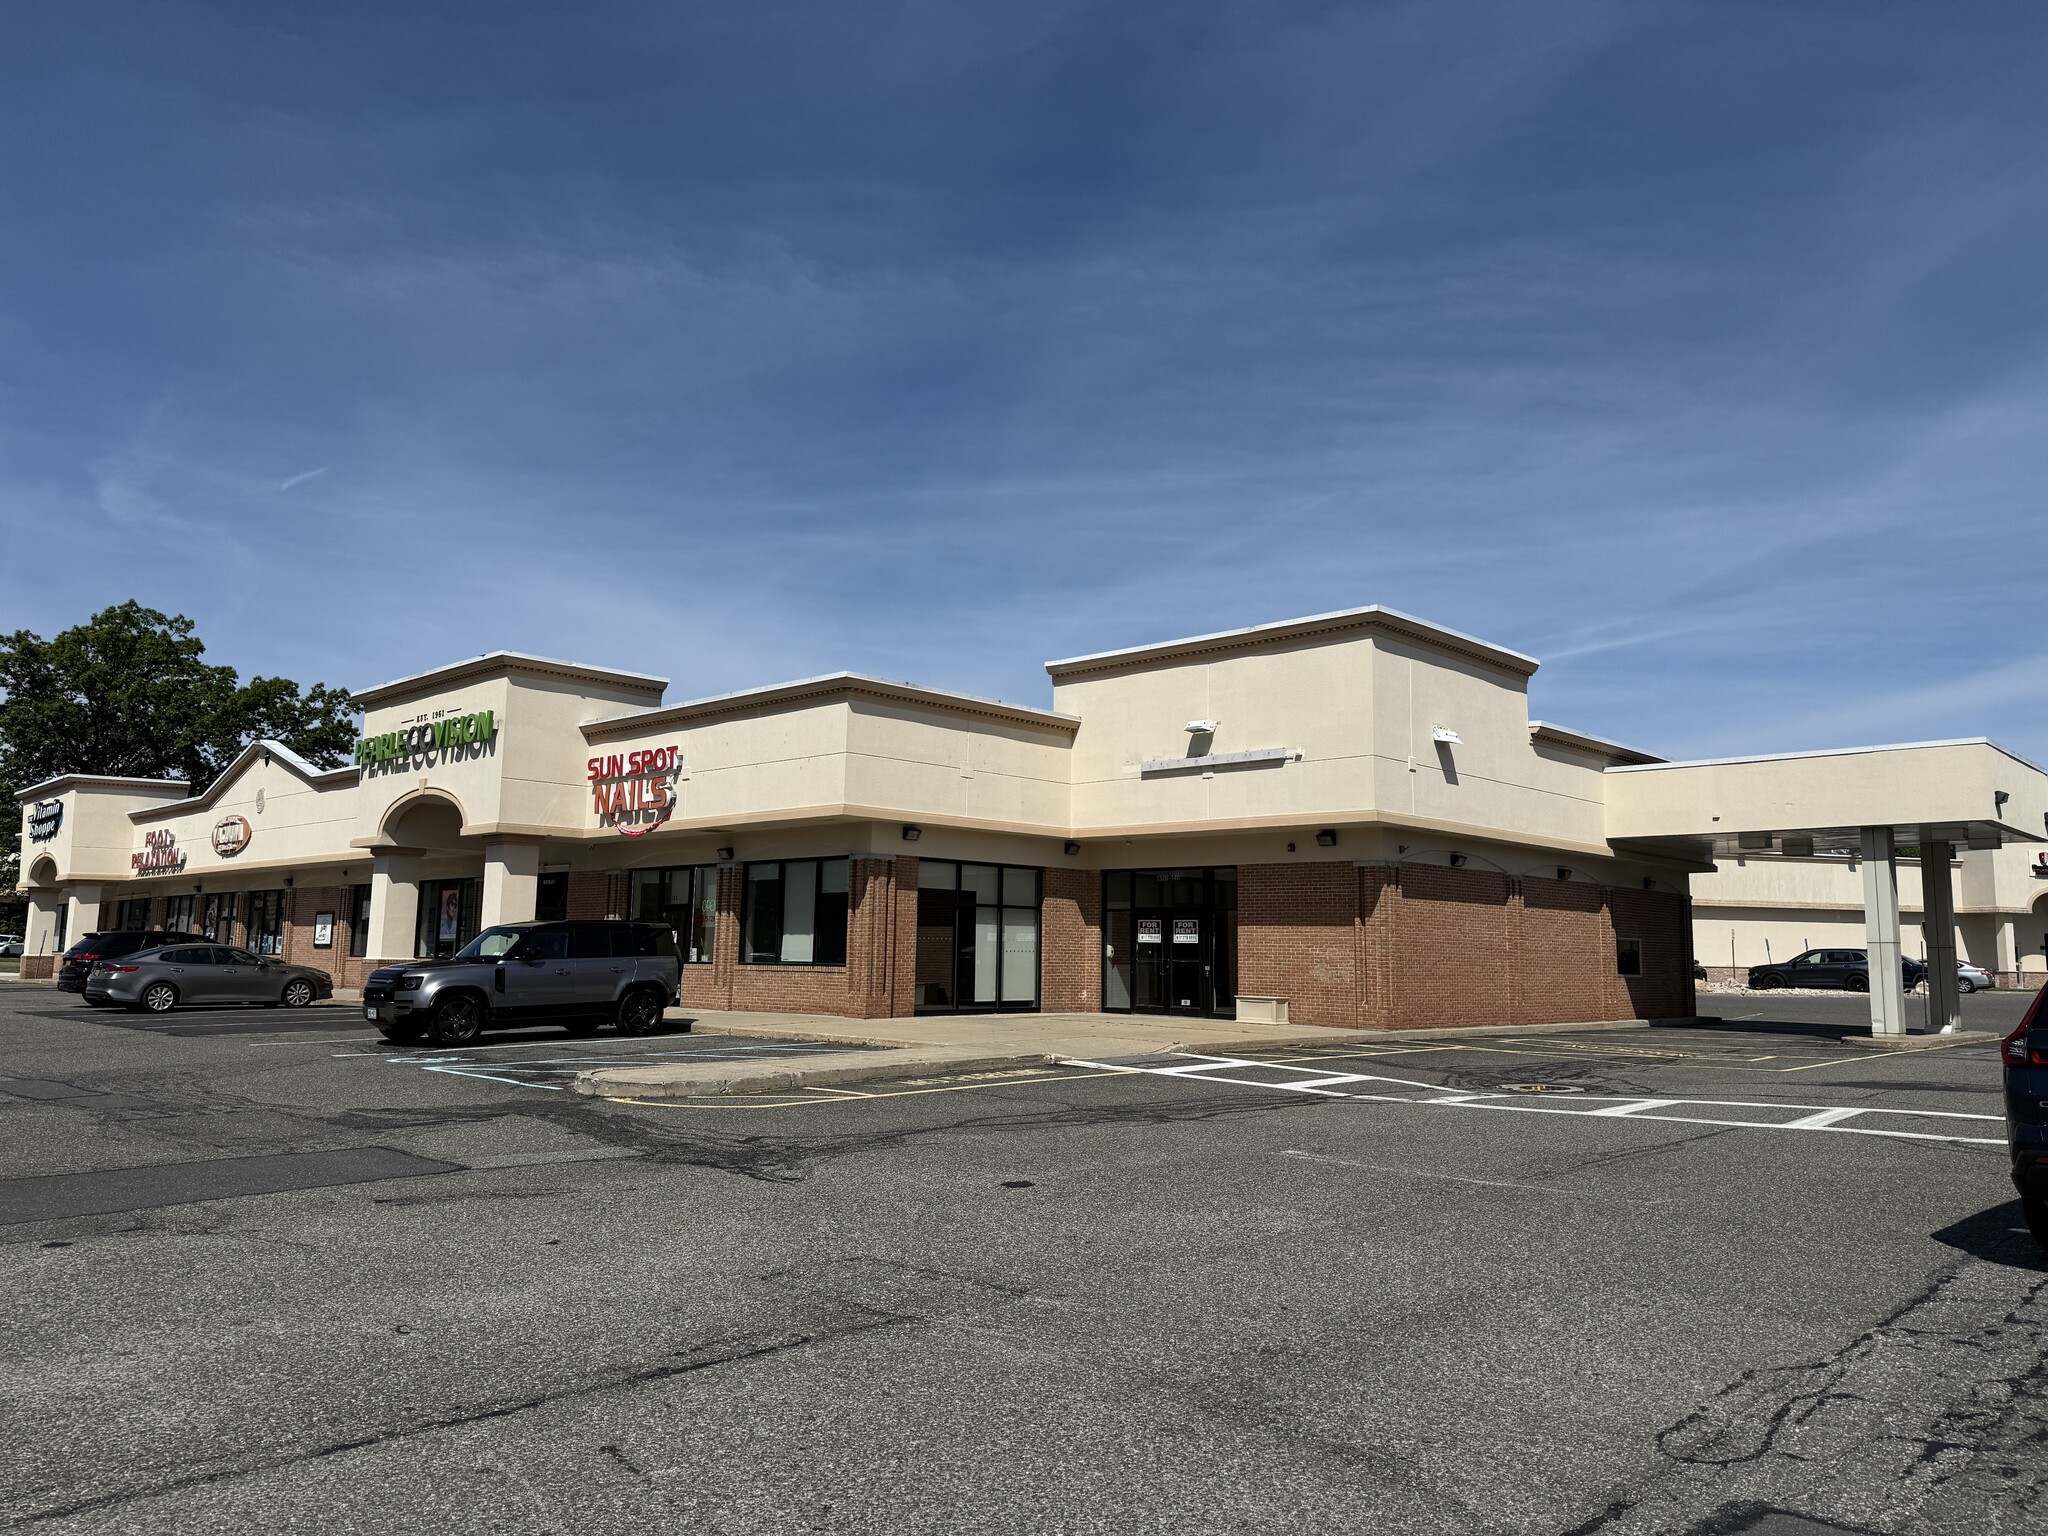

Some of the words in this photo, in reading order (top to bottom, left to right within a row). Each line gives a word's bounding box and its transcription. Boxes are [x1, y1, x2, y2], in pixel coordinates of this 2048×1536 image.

[416, 713, 429, 723] EST.
[354, 729, 409, 766] PEARLE
[434, 709, 495, 749] VISION
[587, 753, 624, 781] SUN
[628, 745, 679, 776] SPOT
[594, 776, 667, 815] NAILS
[33, 801, 61, 821] Vitamin
[29, 819, 56, 838] Shoppe
[145, 829, 170, 848] FOOT
